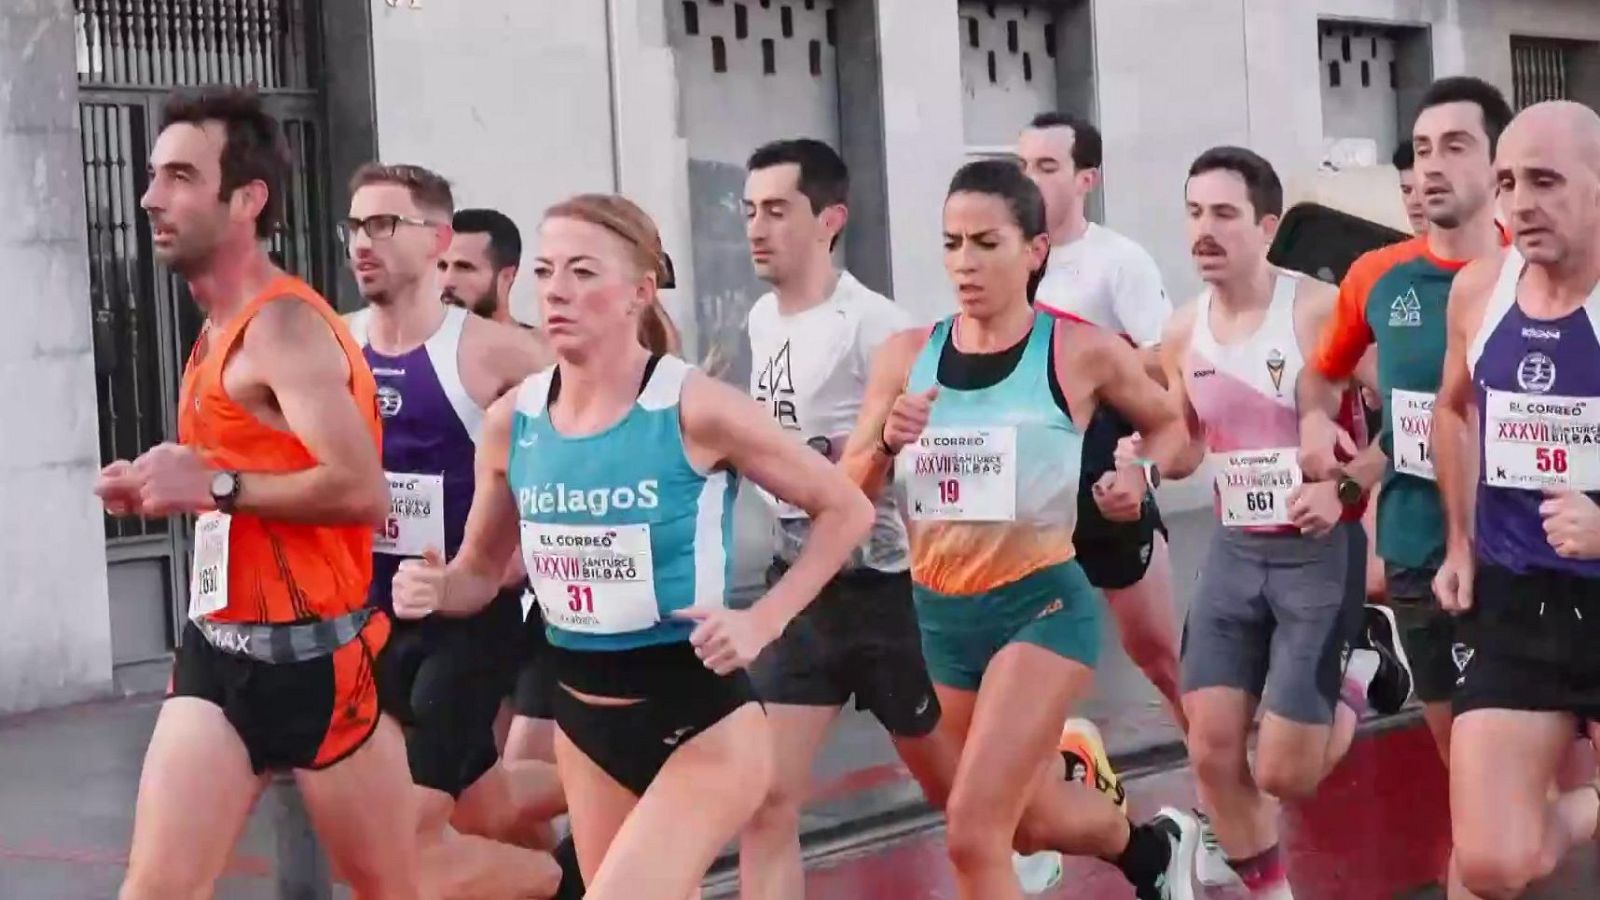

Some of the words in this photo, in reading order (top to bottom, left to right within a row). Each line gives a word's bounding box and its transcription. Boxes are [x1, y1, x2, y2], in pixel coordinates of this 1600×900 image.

[1509, 402, 1523, 412] EL
[1526, 403, 1582, 416] CORREO
[1400, 417, 1432, 437] XXXV
[1498, 422, 1549, 441] XXXVII
[933, 437, 984, 447] CORREO
[1536, 447, 1567, 473] 58
[938, 479, 960, 504] 19
[1246, 492, 1274, 511] 667
[540, 534, 554, 545] EL
[556, 534, 613, 548] CORREO
[582, 557, 636, 568] SANTURCE
[582, 567, 637, 580] BILBAO
[567, 584, 594, 614] 31
